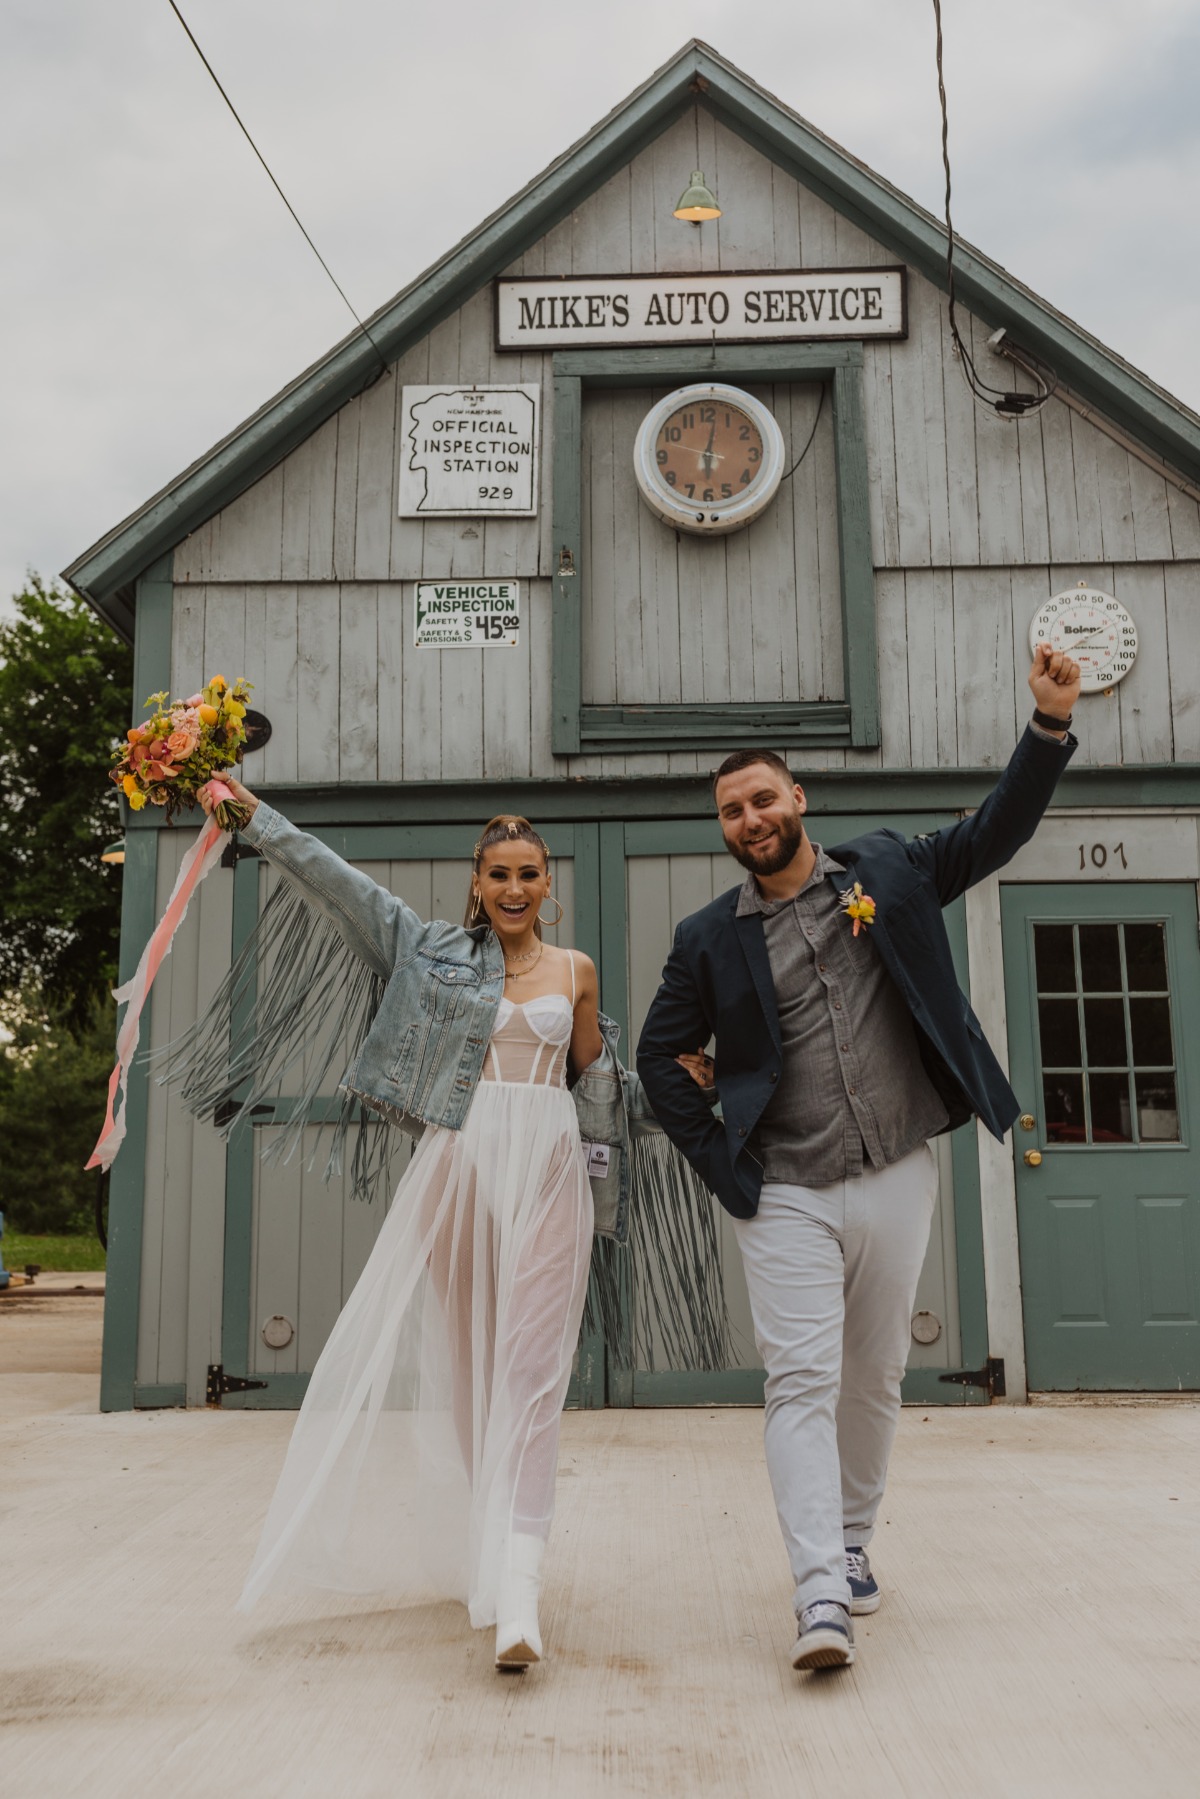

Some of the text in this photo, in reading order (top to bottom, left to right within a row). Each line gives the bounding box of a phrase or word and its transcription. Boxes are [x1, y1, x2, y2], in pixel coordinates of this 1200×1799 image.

[518, 288, 882, 330] MIKE'S AUTO SERVICE
[683, 414, 694, 429] 11
[700, 408, 716, 422] 12
[725, 413, 730, 428] 1
[432, 420, 518, 434] OFFICIAL
[665, 427, 681, 442] 10
[739, 426, 750, 440] 2
[424, 440, 530, 455] INSPECTION
[748, 447, 760, 462] 3
[656, 450, 668, 465] 9
[443, 460, 518, 473] STATION
[665, 471, 676, 486] 8
[740, 469, 750, 484] 4
[479, 487, 513, 499] 929
[685, 484, 696, 499] 7
[703, 488, 713, 502] 6
[721, 484, 732, 499] 5
[434, 586, 509, 599] VEHICLE
[428, 599, 514, 613] INSPECTION
[1079, 842, 1128, 870] 101
